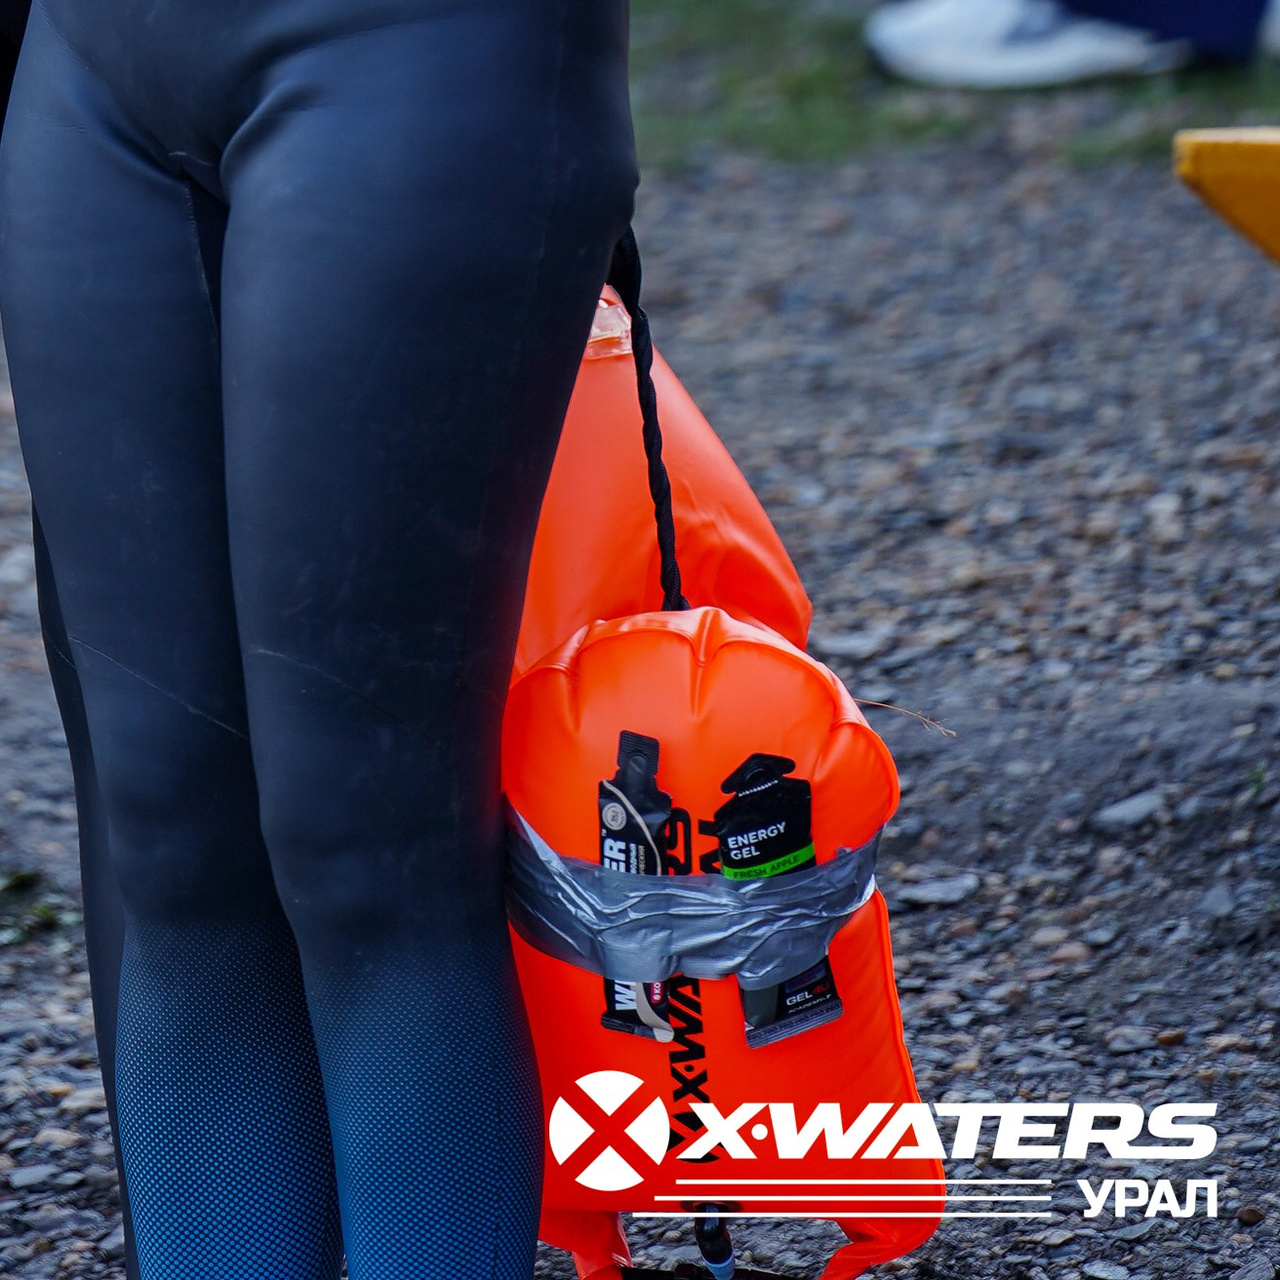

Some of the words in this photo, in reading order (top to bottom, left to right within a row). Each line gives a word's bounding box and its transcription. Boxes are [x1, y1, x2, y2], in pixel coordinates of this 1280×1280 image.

[726, 821, 787, 850] ENERGY
[730, 844, 761, 861] GEL
[733, 866, 768, 880] FRESH
[770, 854, 801, 872] APPLE
